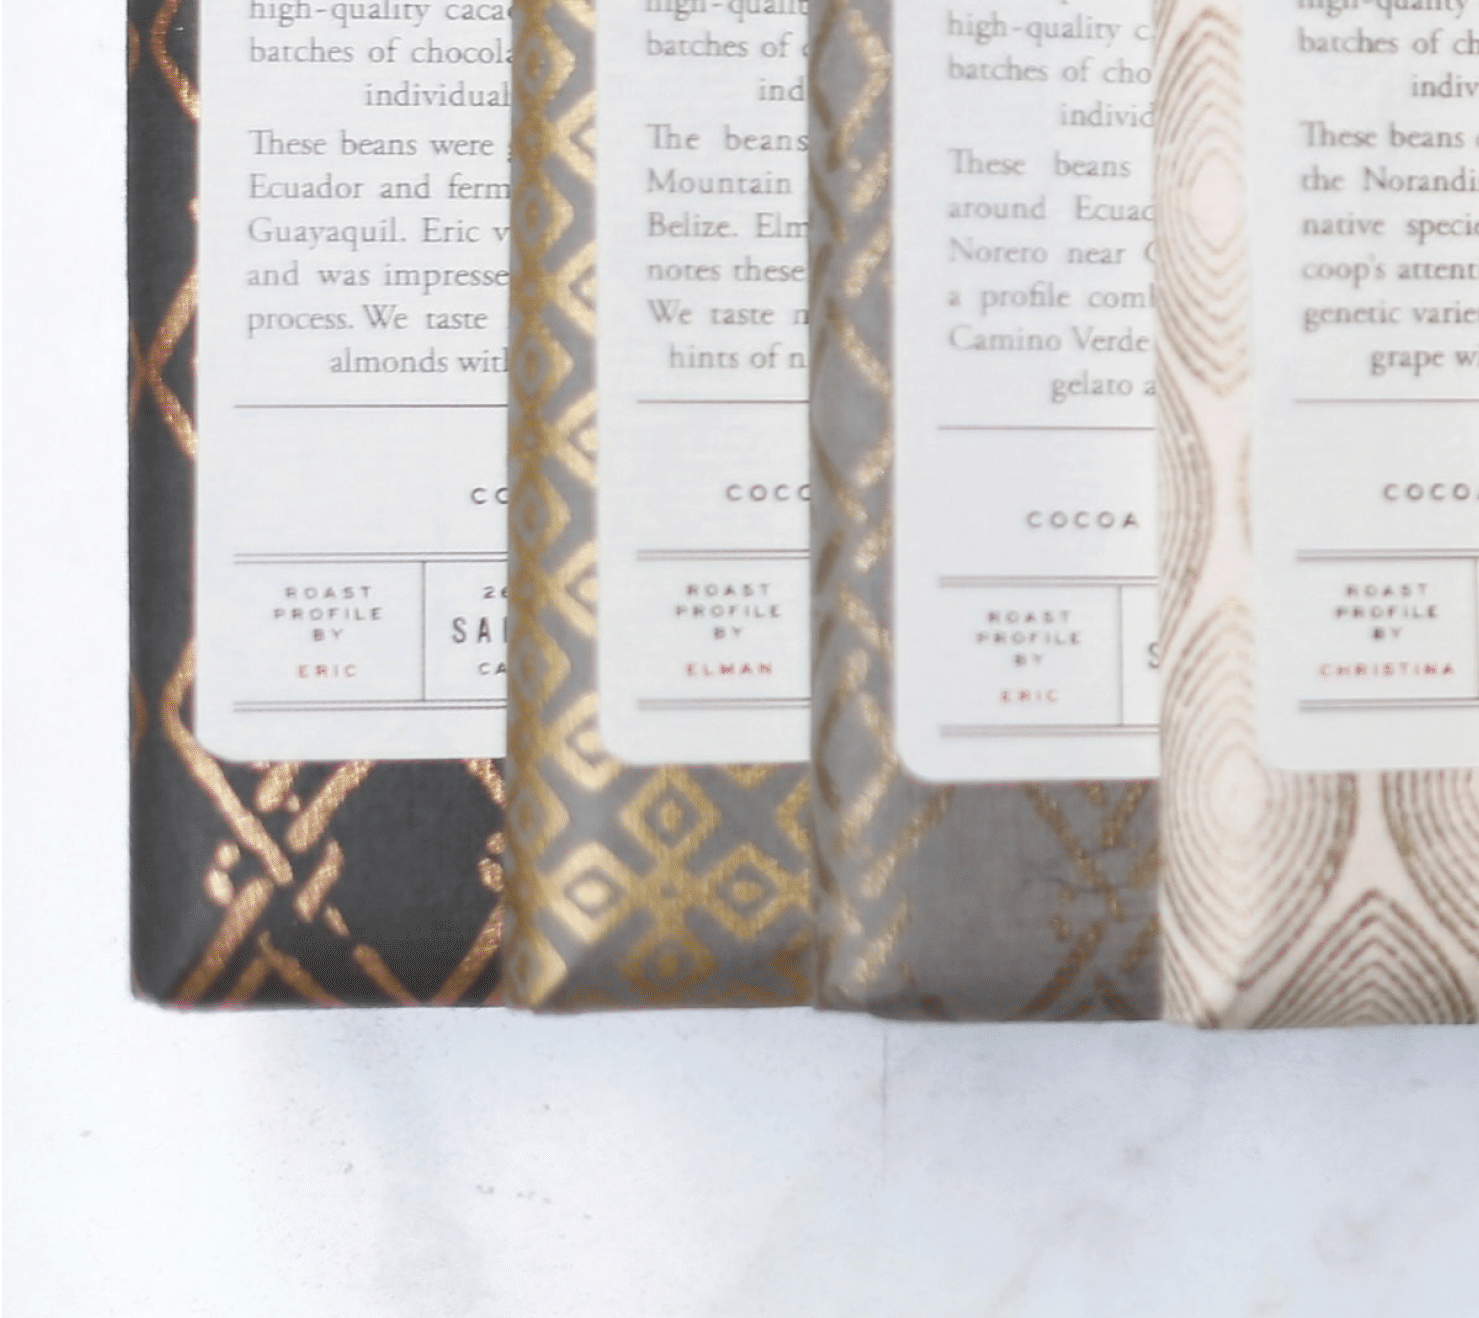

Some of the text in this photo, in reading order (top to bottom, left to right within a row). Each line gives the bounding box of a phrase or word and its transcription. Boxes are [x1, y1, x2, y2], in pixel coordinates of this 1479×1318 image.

[247, 128, 328, 156] These
[644, 122, 701, 151] The
[1052, 149, 1132, 179] beans
[248, 171, 365, 200] Ecuador
[646, 166, 793, 196] Mountain
[647, 210, 739, 239] Belize.
[948, 236, 1049, 265] Norero
[645, 263, 721, 282] notes
[709, 307, 775, 326] taste
[946, 324, 1151, 353] Camino Verde
[328, 346, 448, 374] almonds
[667, 342, 740, 370] hints
[1024, 509, 1137, 530] COCOA
[272, 606, 381, 622] PROFILE
